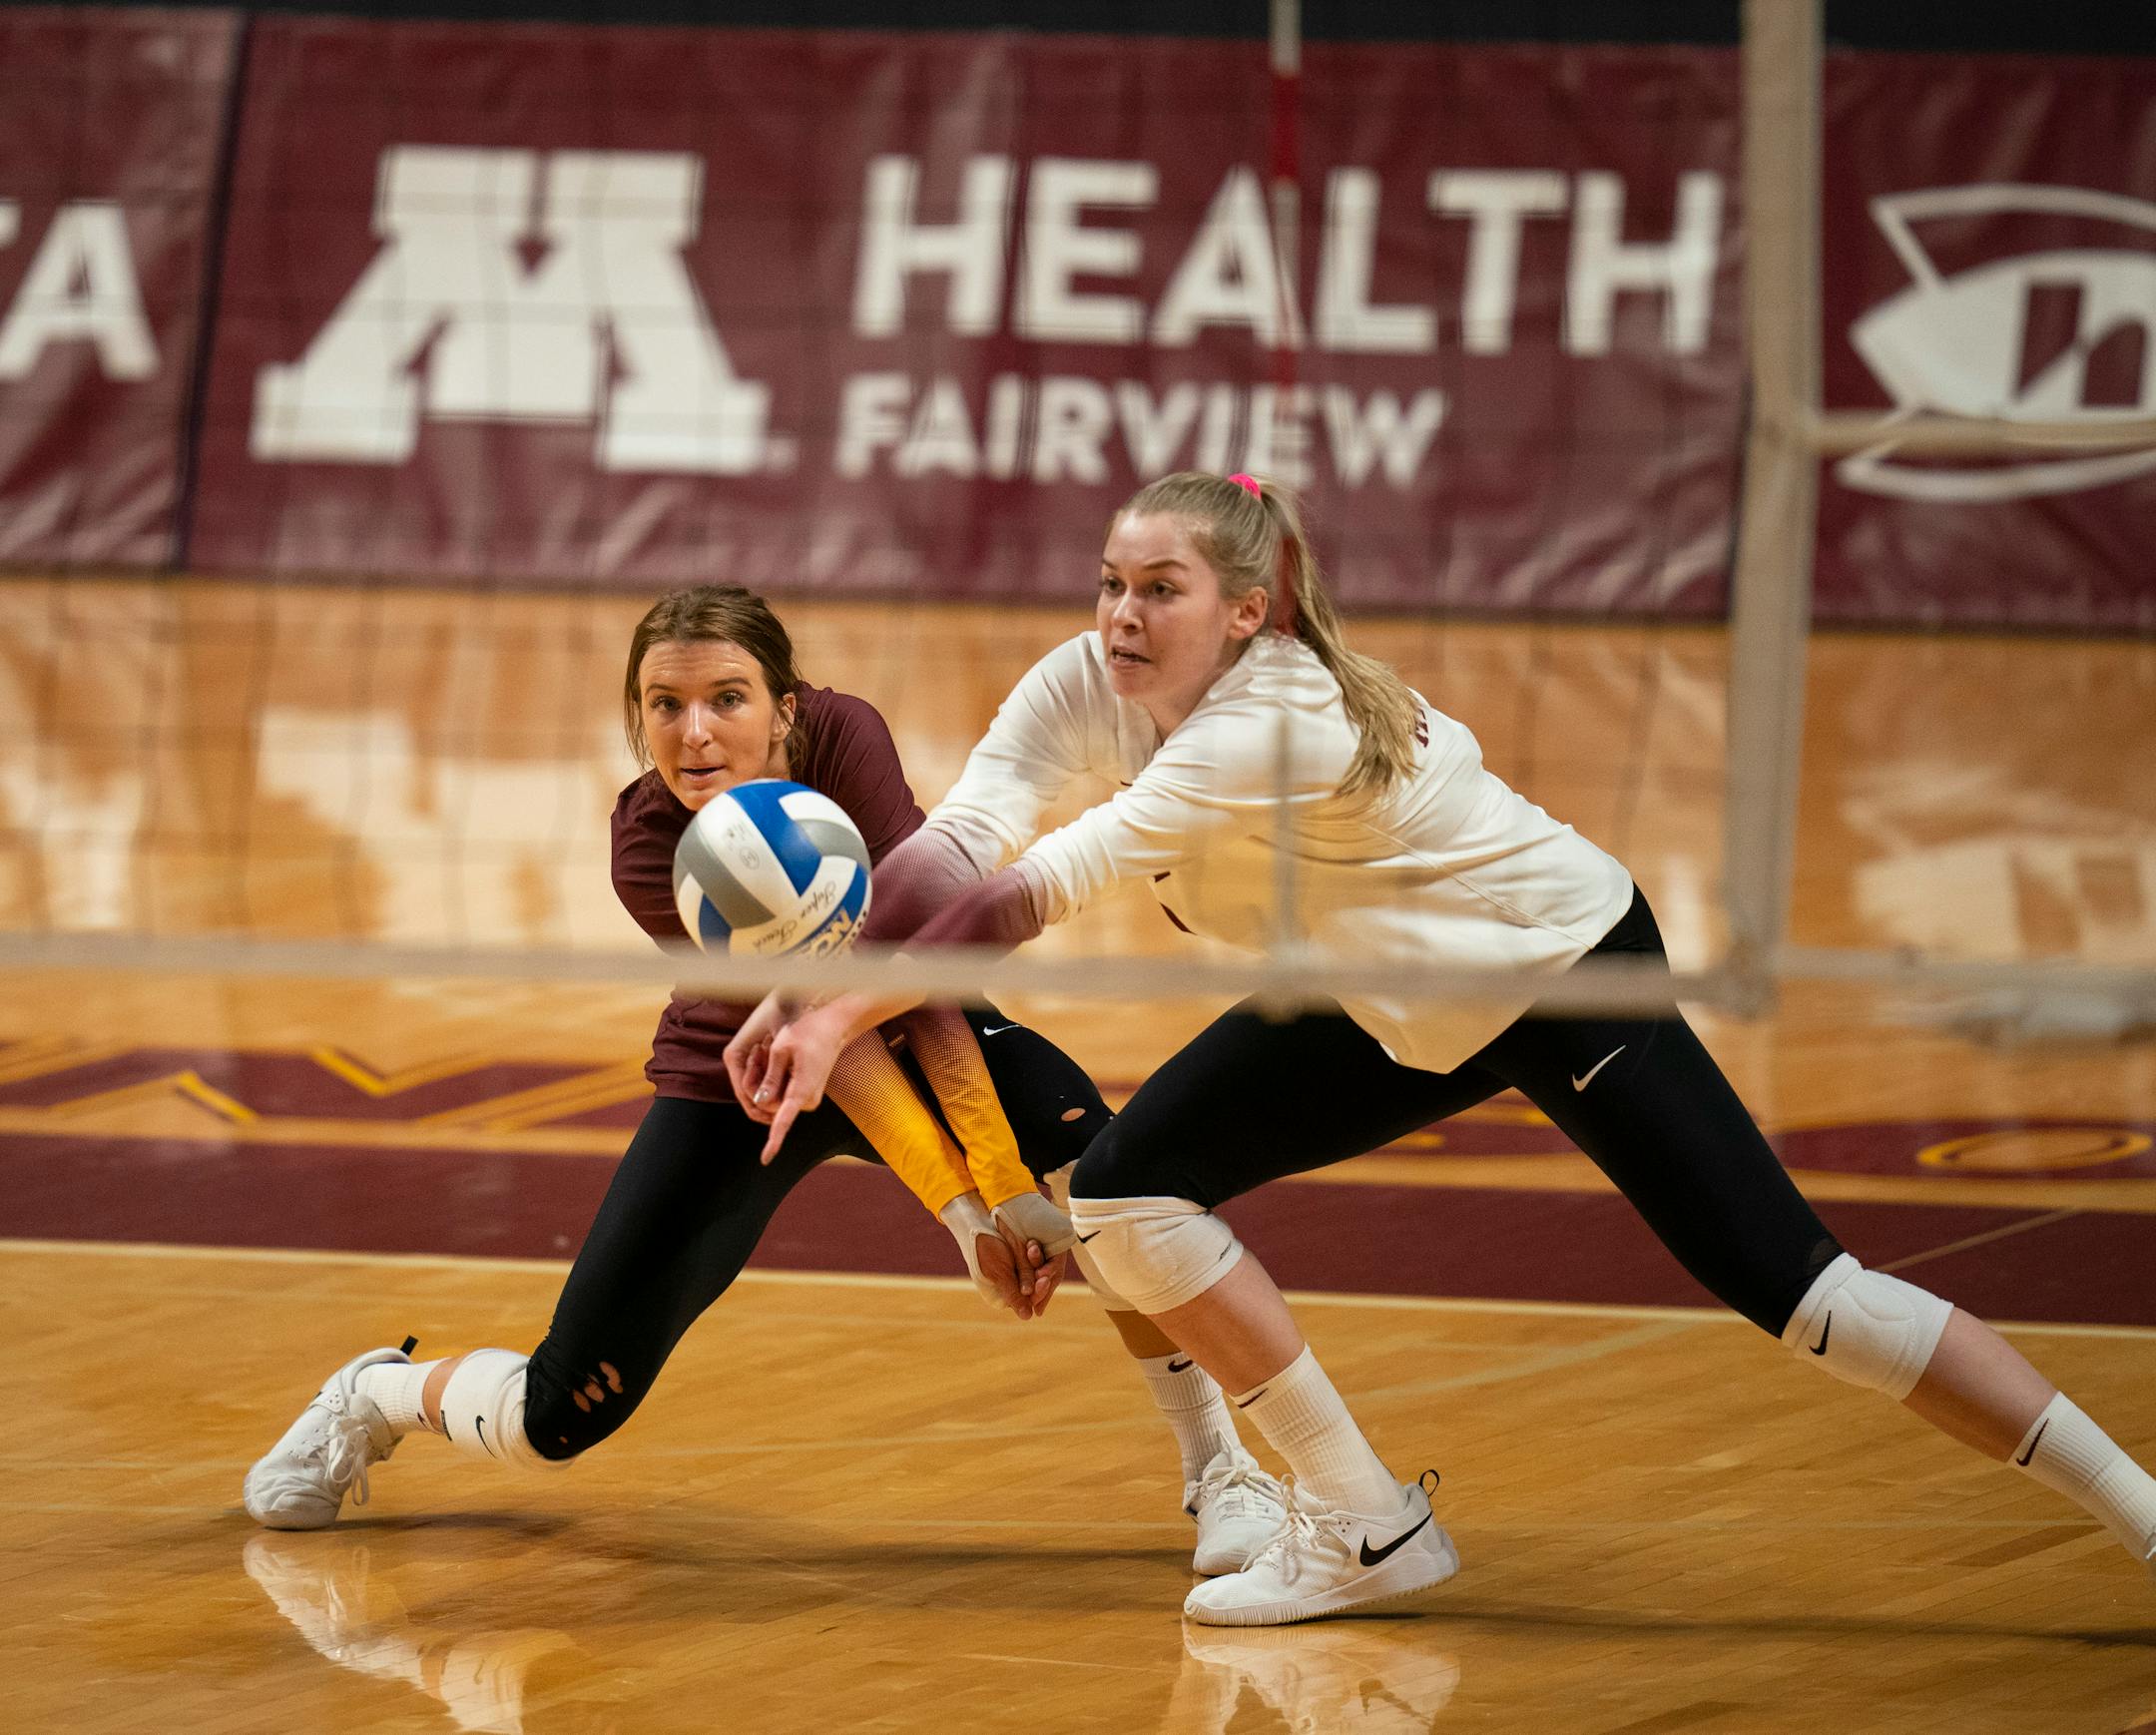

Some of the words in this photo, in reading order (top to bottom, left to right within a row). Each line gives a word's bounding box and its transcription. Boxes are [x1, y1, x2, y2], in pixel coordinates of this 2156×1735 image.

[0, 198, 160, 383] A
[248, 145, 771, 475] M
[851, 154, 1728, 357] HEALTH
[834, 370, 1449, 490] FAIRVIEW
